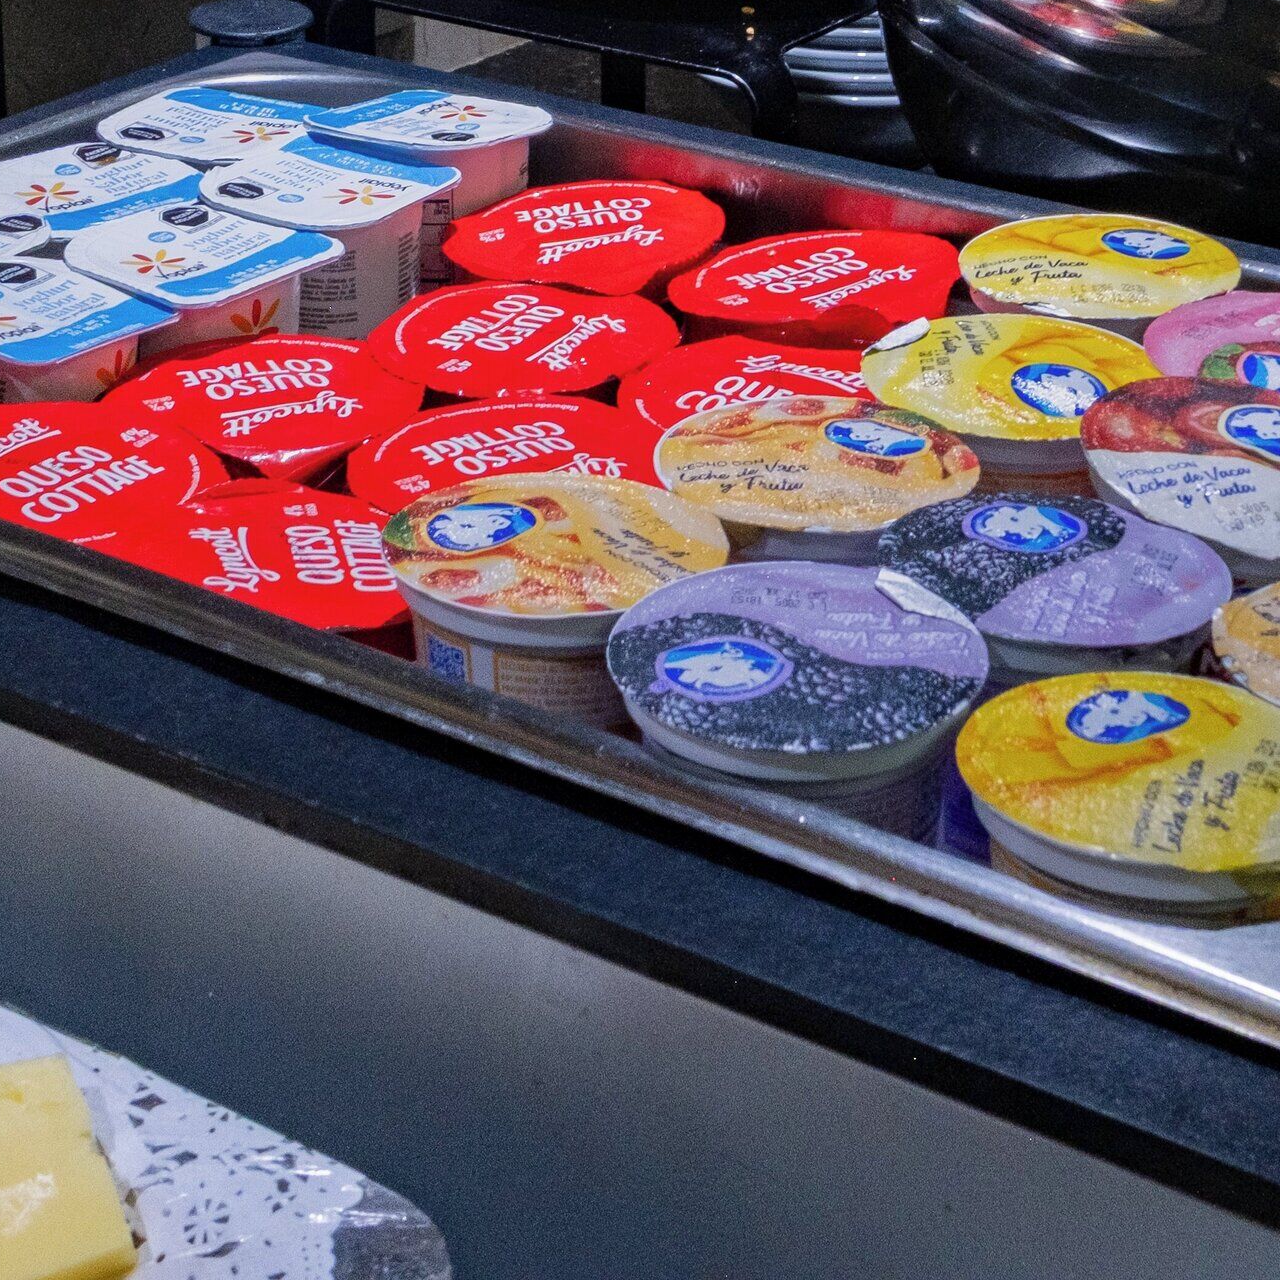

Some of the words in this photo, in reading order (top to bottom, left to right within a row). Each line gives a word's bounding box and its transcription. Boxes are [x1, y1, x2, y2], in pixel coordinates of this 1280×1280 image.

[514, 197, 652, 222] COTTAGE
[532, 208, 643, 233] QUESO
[480, 232, 506, 243] 4%
[536, 224, 665, 265] Lyncott
[726, 247, 856, 290] COTTAGE
[975, 267, 1018, 279] Leche
[1023, 261, 1043, 270] de
[1048, 259, 1089, 268] Vaca
[1018, 254, 1048, 262] CON
[764, 259, 869, 294] QUESO
[800, 265, 917, 309] Lyncott
[1010, 275, 1024, 286] y
[1029, 270, 1082, 283] Fruta
[426, 295, 540, 352] COTTAGE
[474, 305, 565, 352] QUESO
[525, 314, 627, 372] Lyncott
[176, 358, 334, 388] COTTAGE
[205, 373, 331, 401] QUESO
[735, 354, 869, 394] Lyncot
[713, 375, 795, 401] QUE
[148, 400, 176, 412] 4%
[220, 391, 364, 438] Lyncott
[492, 403, 516, 411] leche
[534, 403, 580, 413] Elaborado
[119, 426, 151, 444] 4%
[410, 421, 566, 466] COTTAGE
[453, 437, 576, 476] QUESO
[678, 472, 731, 483] Leche
[736, 468, 759, 476] de
[764, 459, 810, 472] Vaca
[20, 455, 166, 523] COTTAGE
[399, 479, 432, 494] 4%
[720, 481, 738, 493] y
[744, 475, 805, 491] Fruta
[1127, 478, 1178, 495] Leche
[1183, 471, 1204, 484] de
[1204, 466, 1252, 481] Vaca
[1177, 493, 1193, 508] y
[1196, 483, 1257, 505] Fruta
[188, 526, 281, 593] Lyncott
[284, 525, 345, 585] QUESO
[333, 519, 398, 592] COTTAGE
[826, 612, 893, 630] Fruta
[814, 629, 869, 649] Vaca
[1203, 770, 1240, 812] Fruta
[1151, 810, 1188, 853] Leche
[1175, 759, 1206, 787] Vaca
